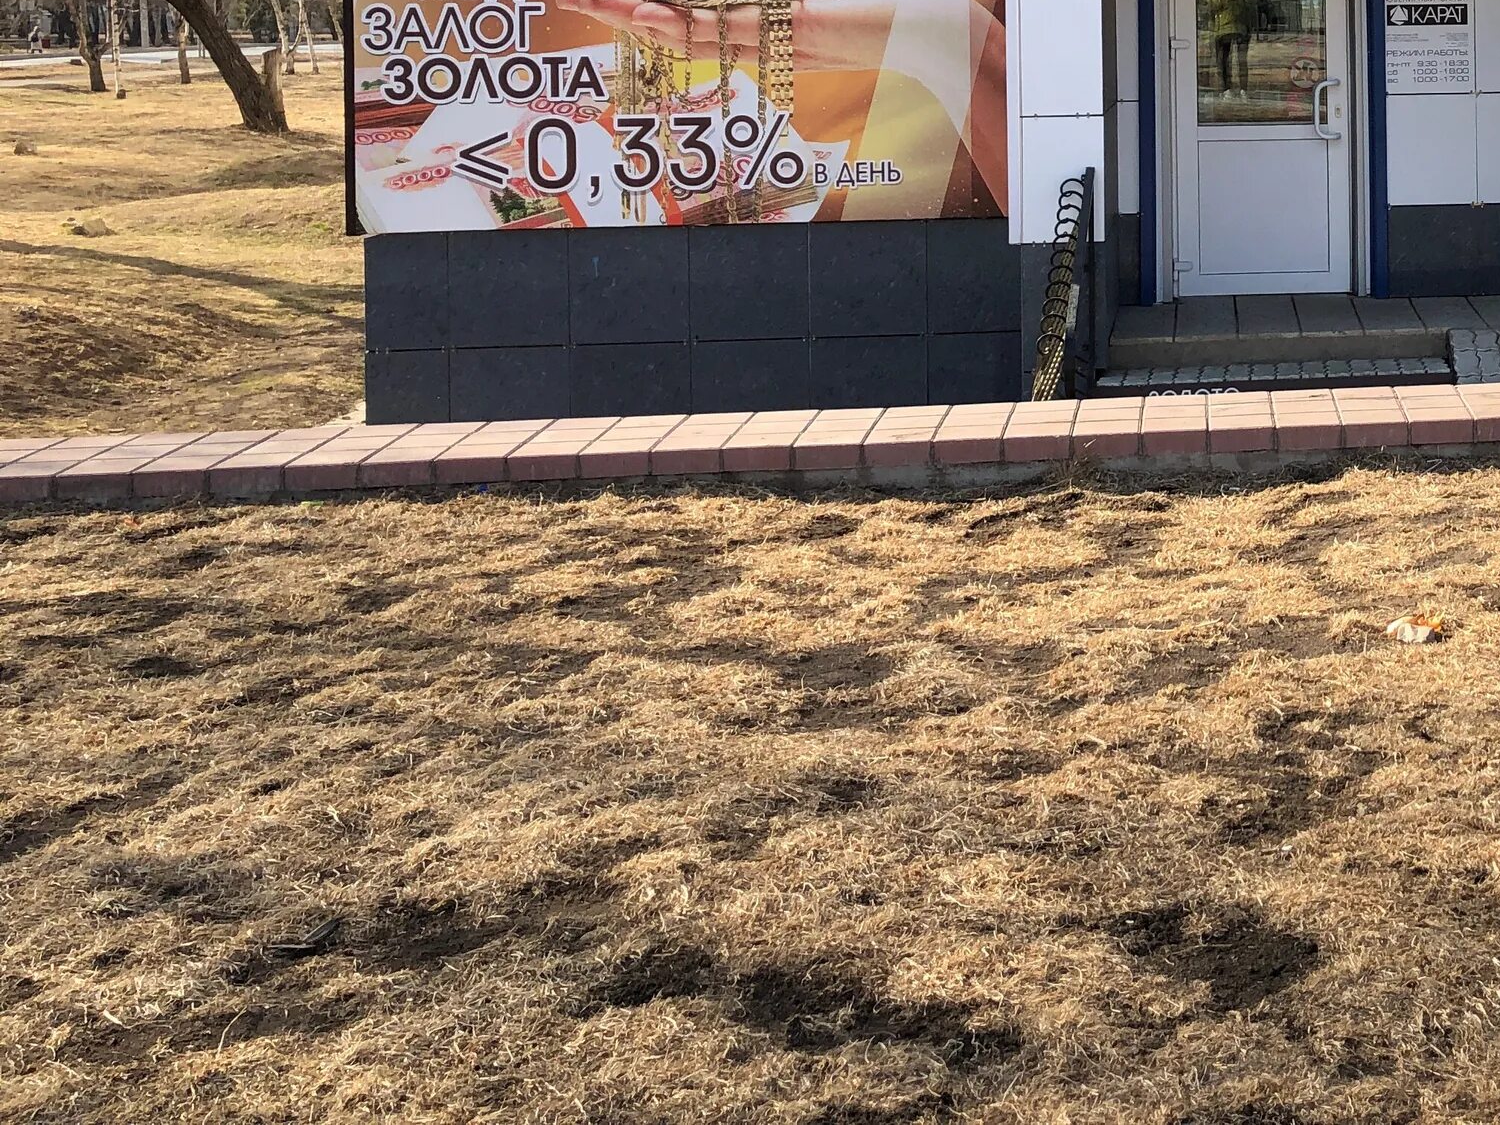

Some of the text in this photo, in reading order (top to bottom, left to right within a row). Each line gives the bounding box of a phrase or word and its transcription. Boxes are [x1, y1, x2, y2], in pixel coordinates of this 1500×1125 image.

[363, 5, 544, 51] ЗАЛОГ
[1411, 6, 1465, 24] КАРАТ
[1386, 49, 1425, 57] РЕЖИМ
[383, 55, 606, 102] ЗОЛОТА
[813, 160, 902, 187] В ДЕНЬ
